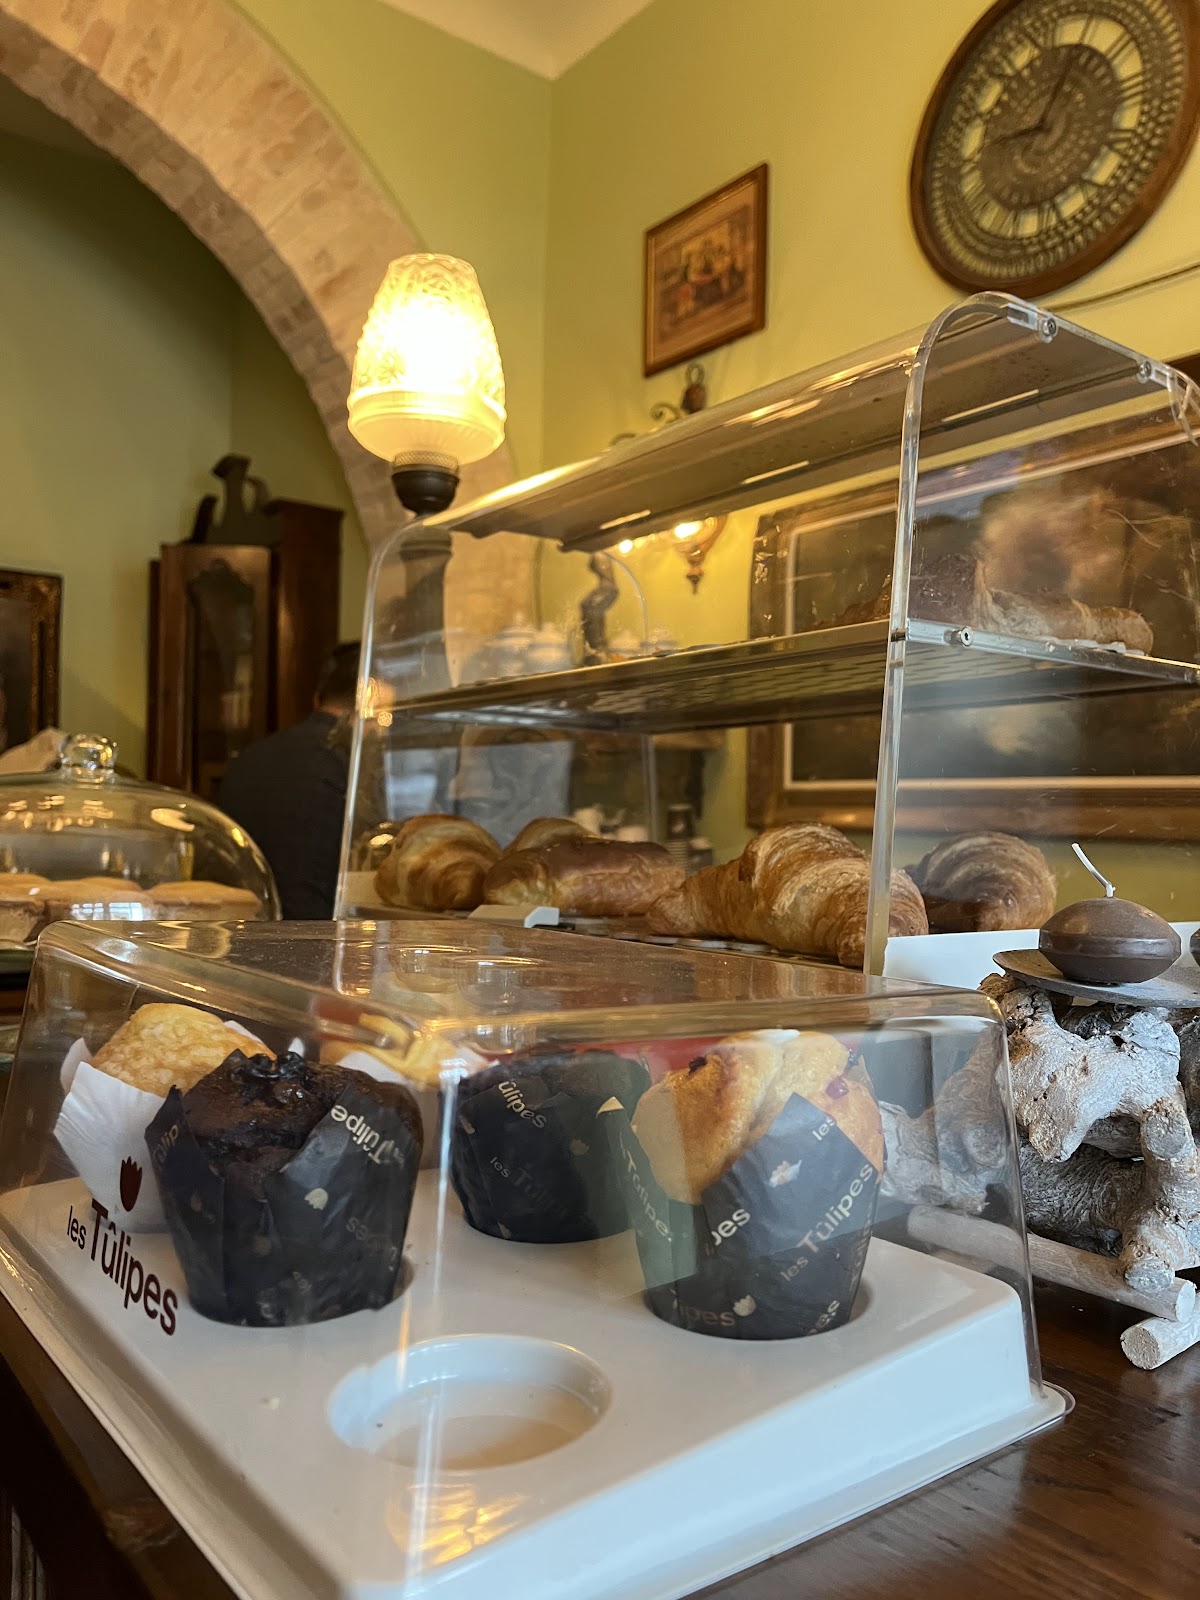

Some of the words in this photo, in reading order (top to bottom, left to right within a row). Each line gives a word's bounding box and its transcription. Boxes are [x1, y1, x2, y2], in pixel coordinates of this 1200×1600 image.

[489, 1156, 512, 1179] les
[780, 1255, 809, 1282] les
[797, 1163, 874, 1253] Tûlipes
[66, 1205, 87, 1250] les
[90, 1198, 179, 1337] Tûlipes
